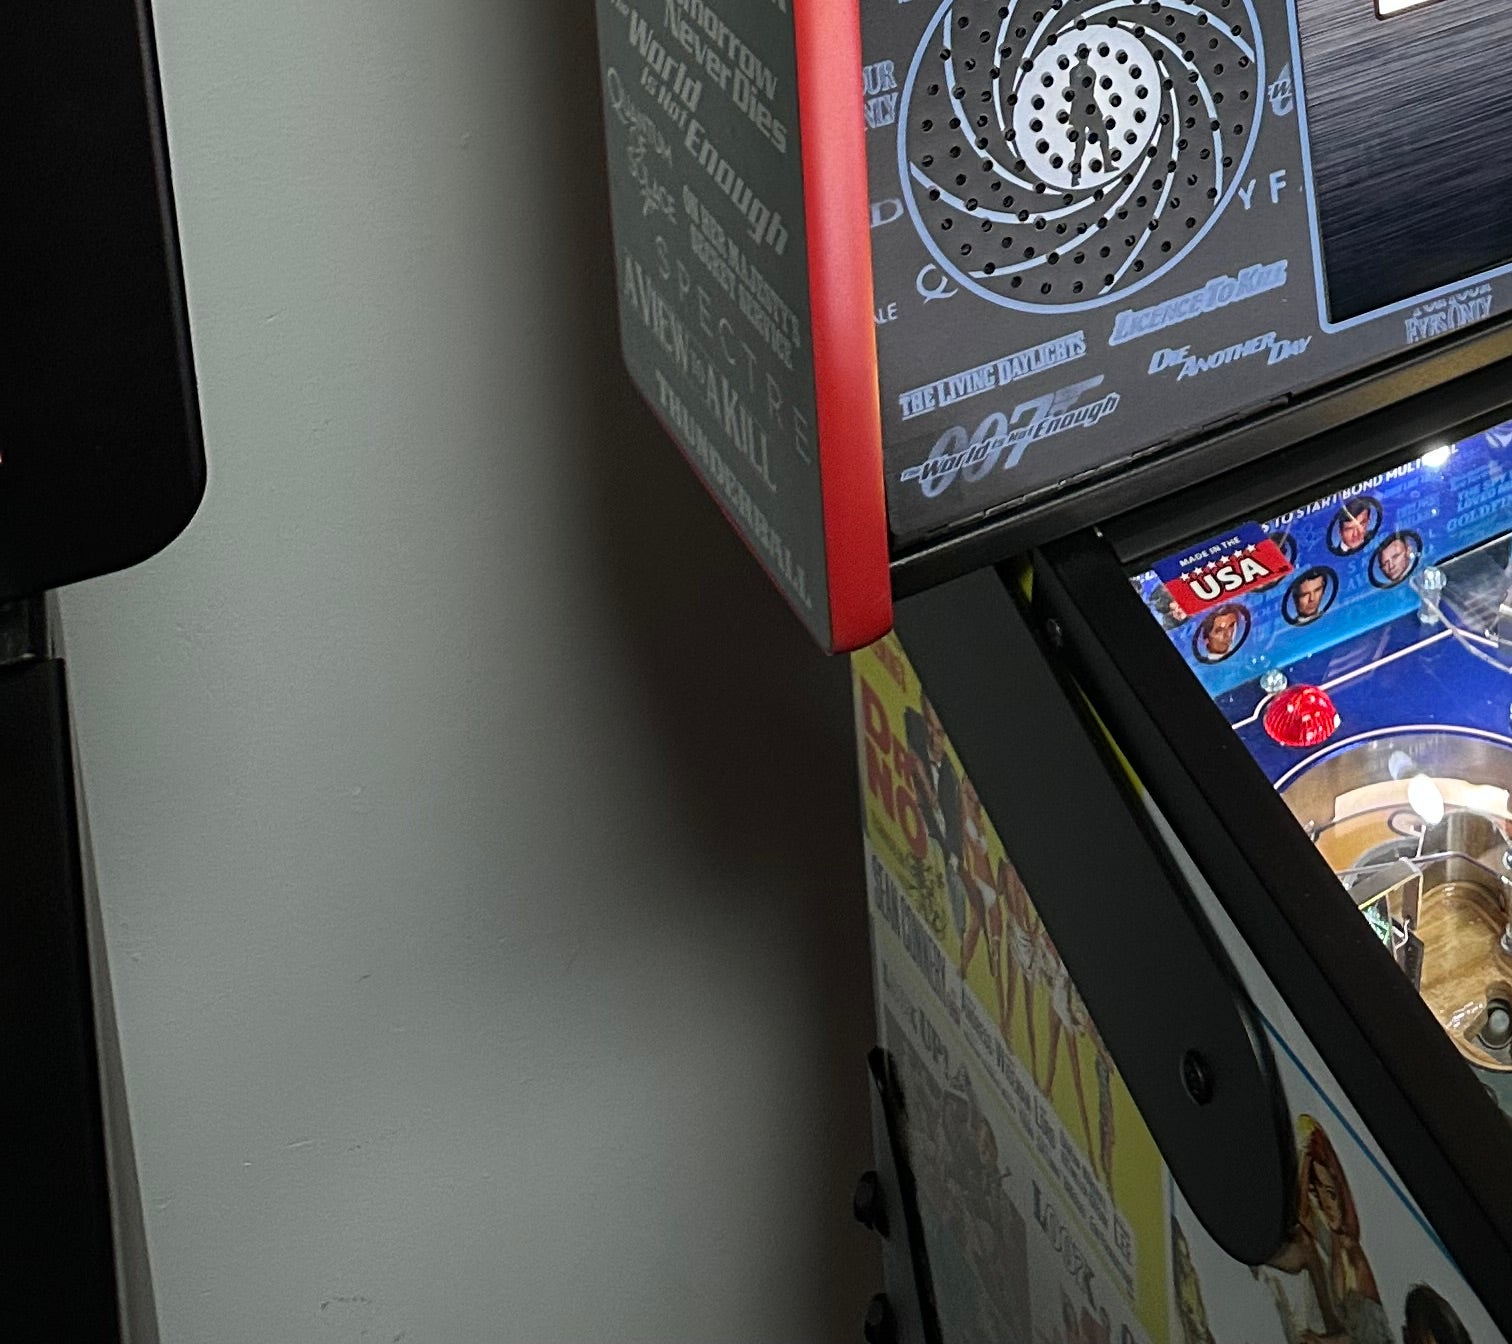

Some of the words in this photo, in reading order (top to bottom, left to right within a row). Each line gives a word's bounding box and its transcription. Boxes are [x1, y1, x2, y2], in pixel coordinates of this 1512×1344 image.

[629, 9, 700, 113] World
[900, 393, 936, 418] THE
[937, 365, 997, 407] LIVING
[998, 334, 1086, 386] DAYLIGHTS
[1178, 549, 1210, 569] MADE
[1210, 545, 1222, 558] IN
[1223, 535, 1242, 552] THE
[1188, 558, 1270, 603] USA
